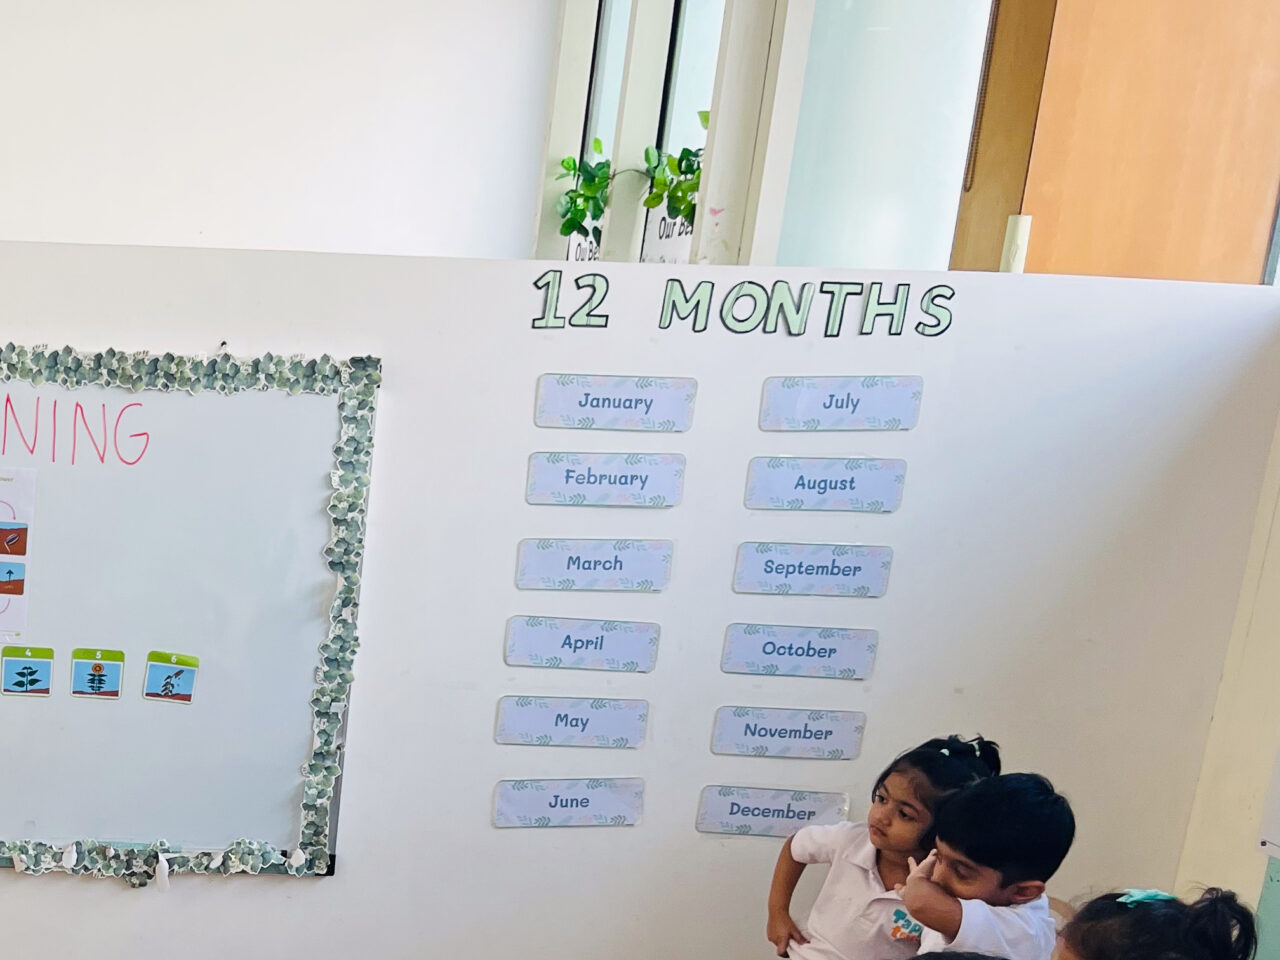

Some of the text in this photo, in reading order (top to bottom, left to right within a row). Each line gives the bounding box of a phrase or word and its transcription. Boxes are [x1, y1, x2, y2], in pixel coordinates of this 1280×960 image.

[658, 216, 694, 240] Our Be
[531, 270, 956, 337] 12 MONTHS
[578, 393, 653, 415] January
[823, 393, 860, 414] July
[565, 467, 648, 490] February
[794, 475, 856, 495] August
[566, 555, 623, 571] March
[763, 559, 862, 579] September
[25, 649, 31, 657] 4
[561, 634, 605, 653] April
[762, 640, 837, 659] October
[96, 651, 102, 659] 5
[171, 656, 177, 664] 6
[554, 713, 589, 732] May
[744, 723, 833, 740] November
[548, 795, 590, 809] June
[729, 802, 816, 820] December
